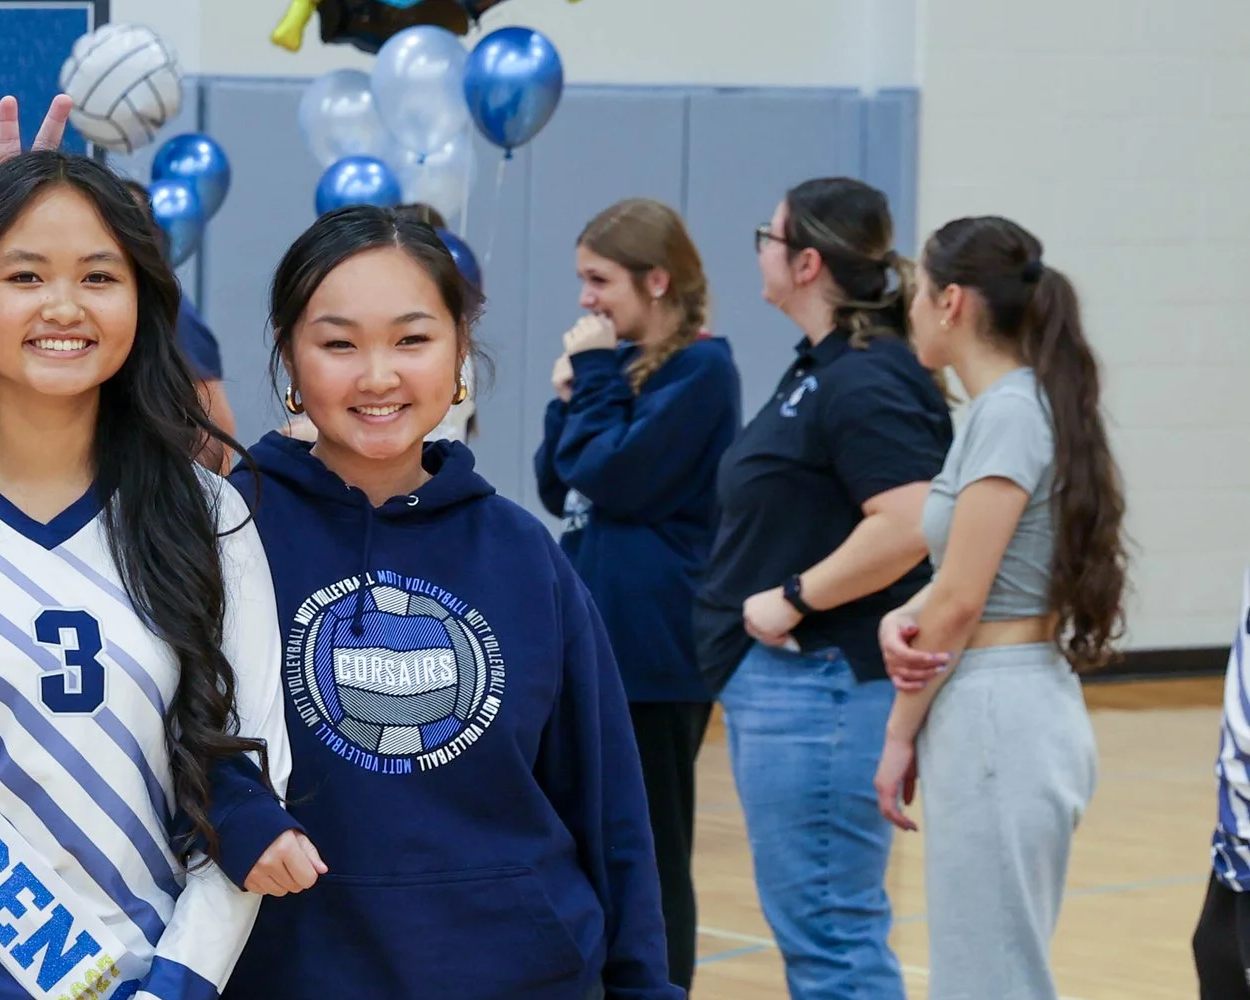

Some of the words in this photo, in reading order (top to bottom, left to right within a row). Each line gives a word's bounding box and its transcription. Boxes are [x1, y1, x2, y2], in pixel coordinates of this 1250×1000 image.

[294, 598, 319, 626] MOTT
[311, 572, 375, 607] VOLLEYBAL
[377, 570, 402, 588] MOTT
[406, 577, 468, 615] VOLLEYBALL
[33, 608, 107, 715] 3
[286, 628, 305, 696] VOLLEYBALL
[338, 653, 453, 687] CORSAIRS
[464, 608, 491, 634] MOTT
[482, 634, 505, 694] VOLLEYBALL
[294, 696, 320, 727] MOTT
[476, 695, 502, 728] MOTT
[315, 723, 379, 772] VOLLEYBALL
[382, 758, 412, 774] MOTT
[417, 723, 484, 771] VOLLEYBALL
